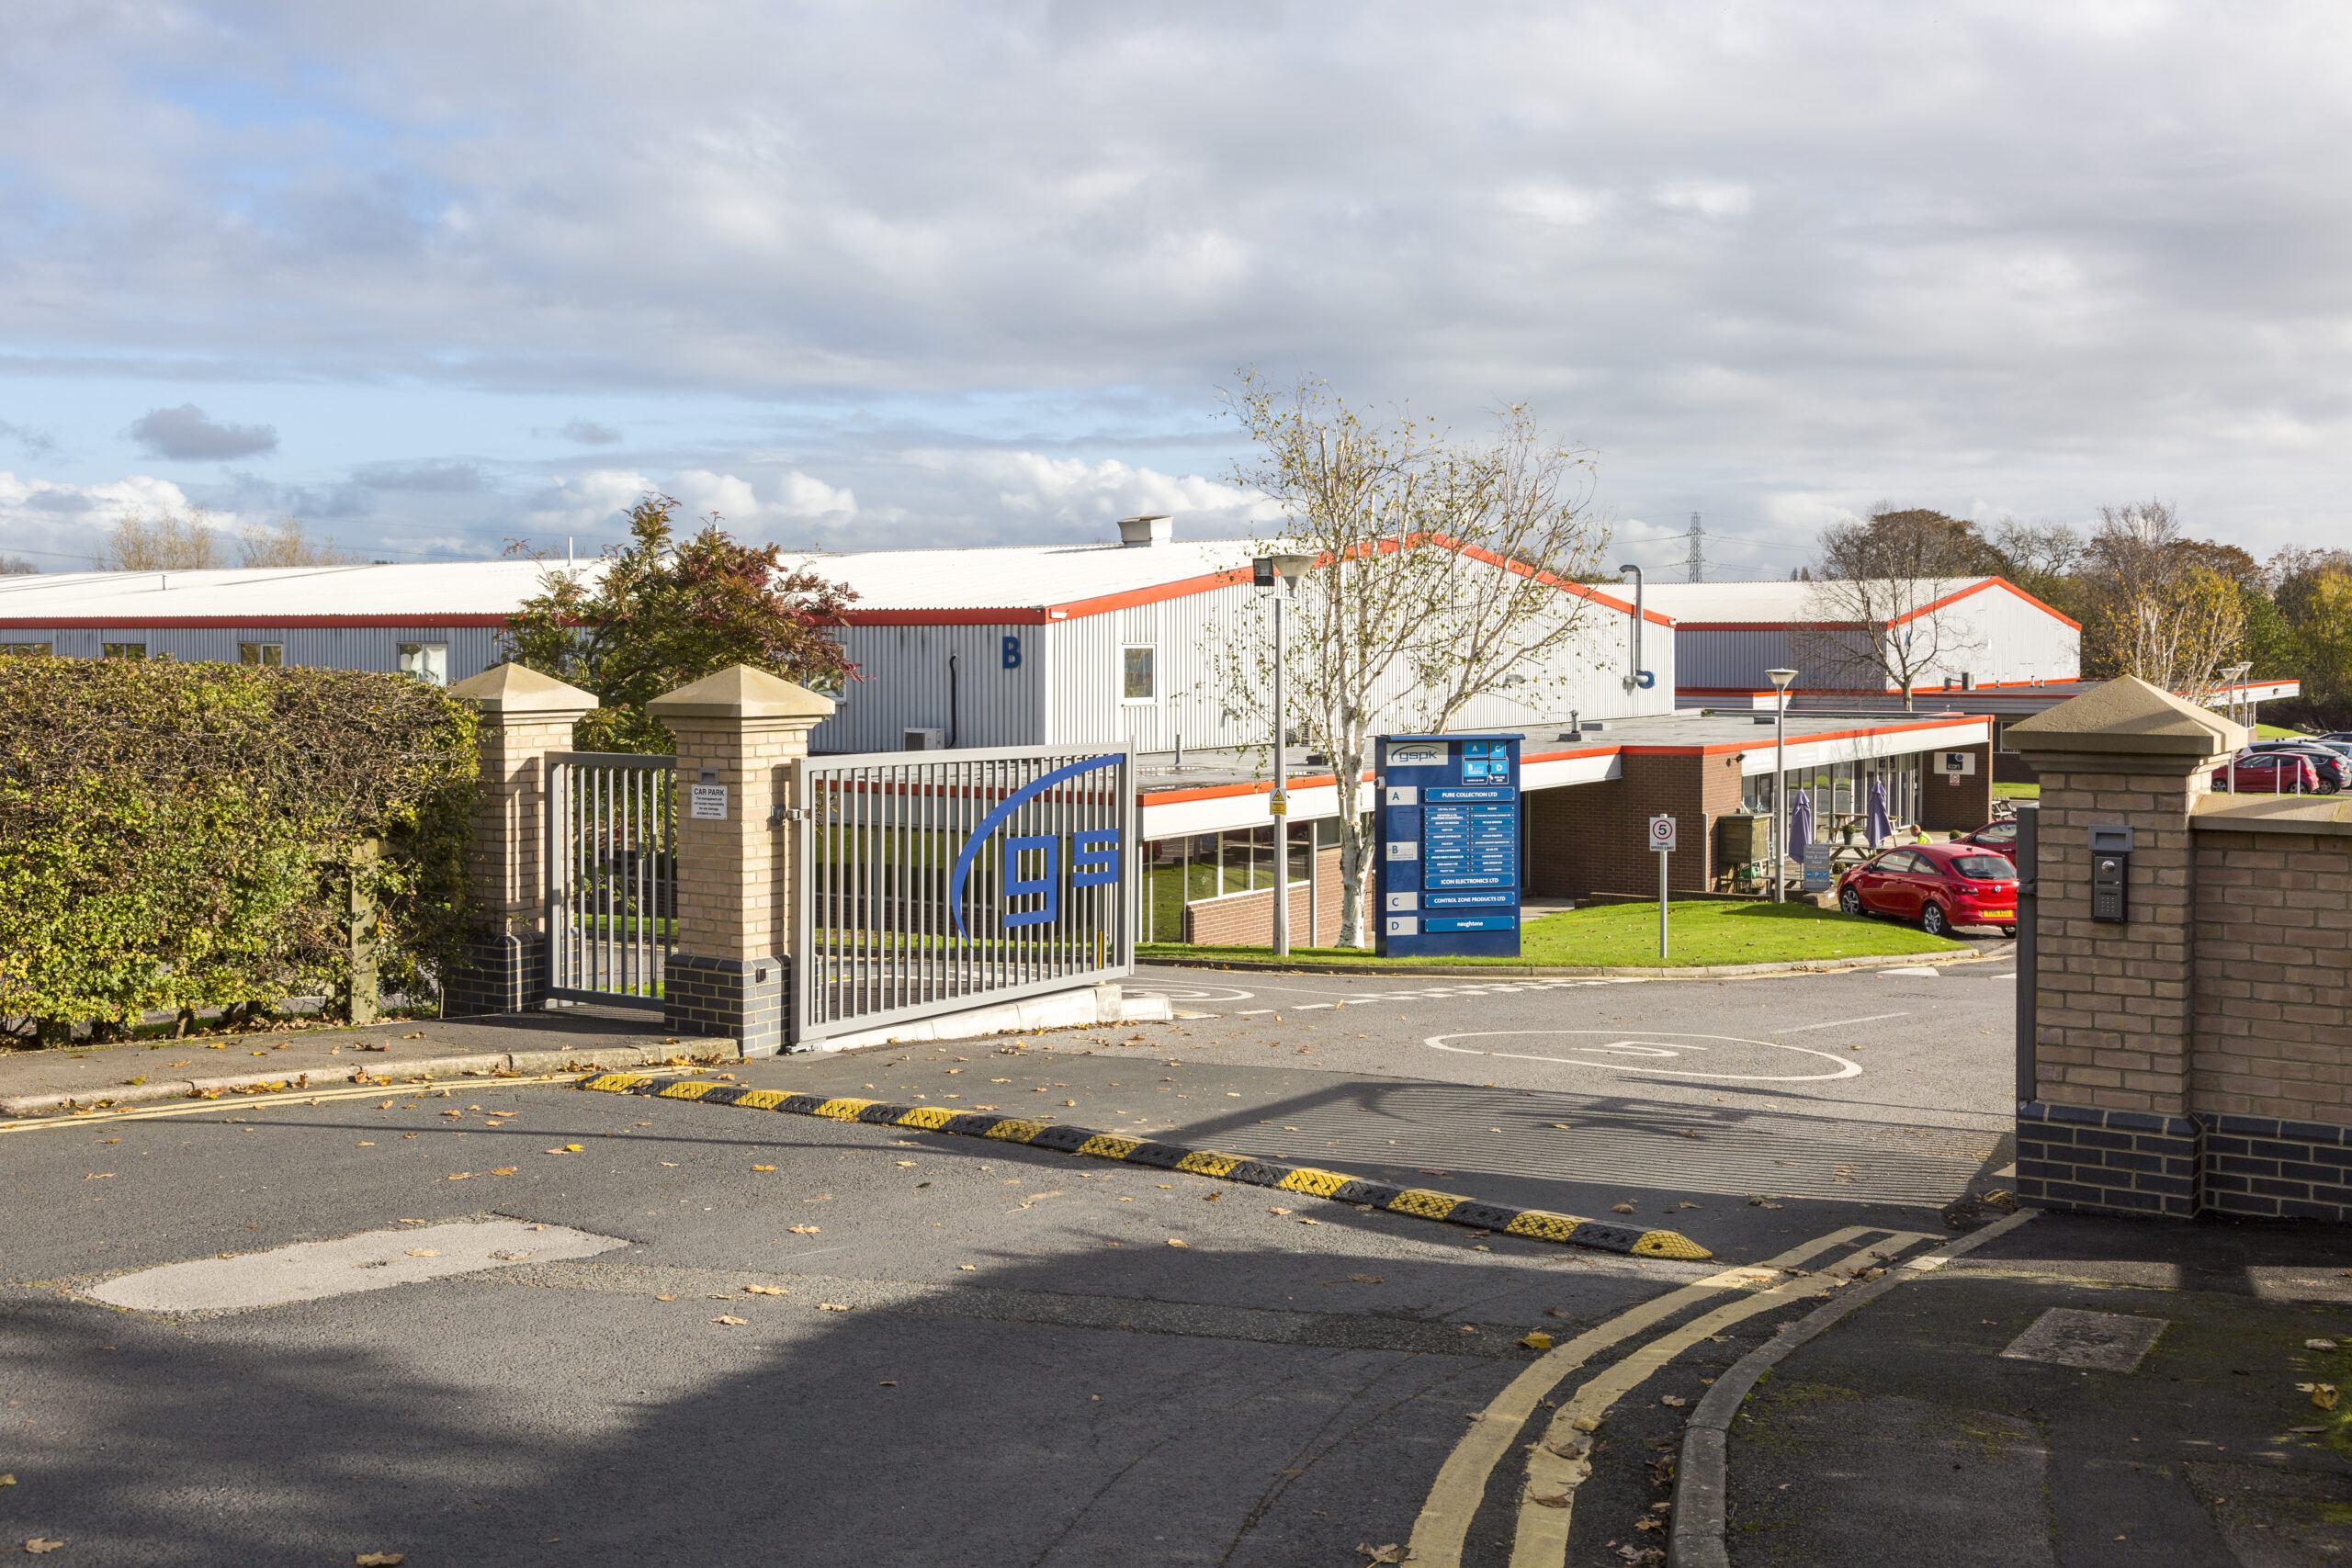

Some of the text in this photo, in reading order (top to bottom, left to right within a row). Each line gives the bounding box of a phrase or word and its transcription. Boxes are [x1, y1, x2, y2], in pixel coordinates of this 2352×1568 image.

[1002, 636, 1022, 669] B
[1399, 751, 1437, 762] gspk
[1392, 792, 1400, 801] A
[1658, 824, 1667, 835] 5
[1392, 845, 1398, 854] B
[1391, 897, 1399, 907] C
[1391, 922, 1399, 931] D
[1571, 1041, 1708, 1057] 5
